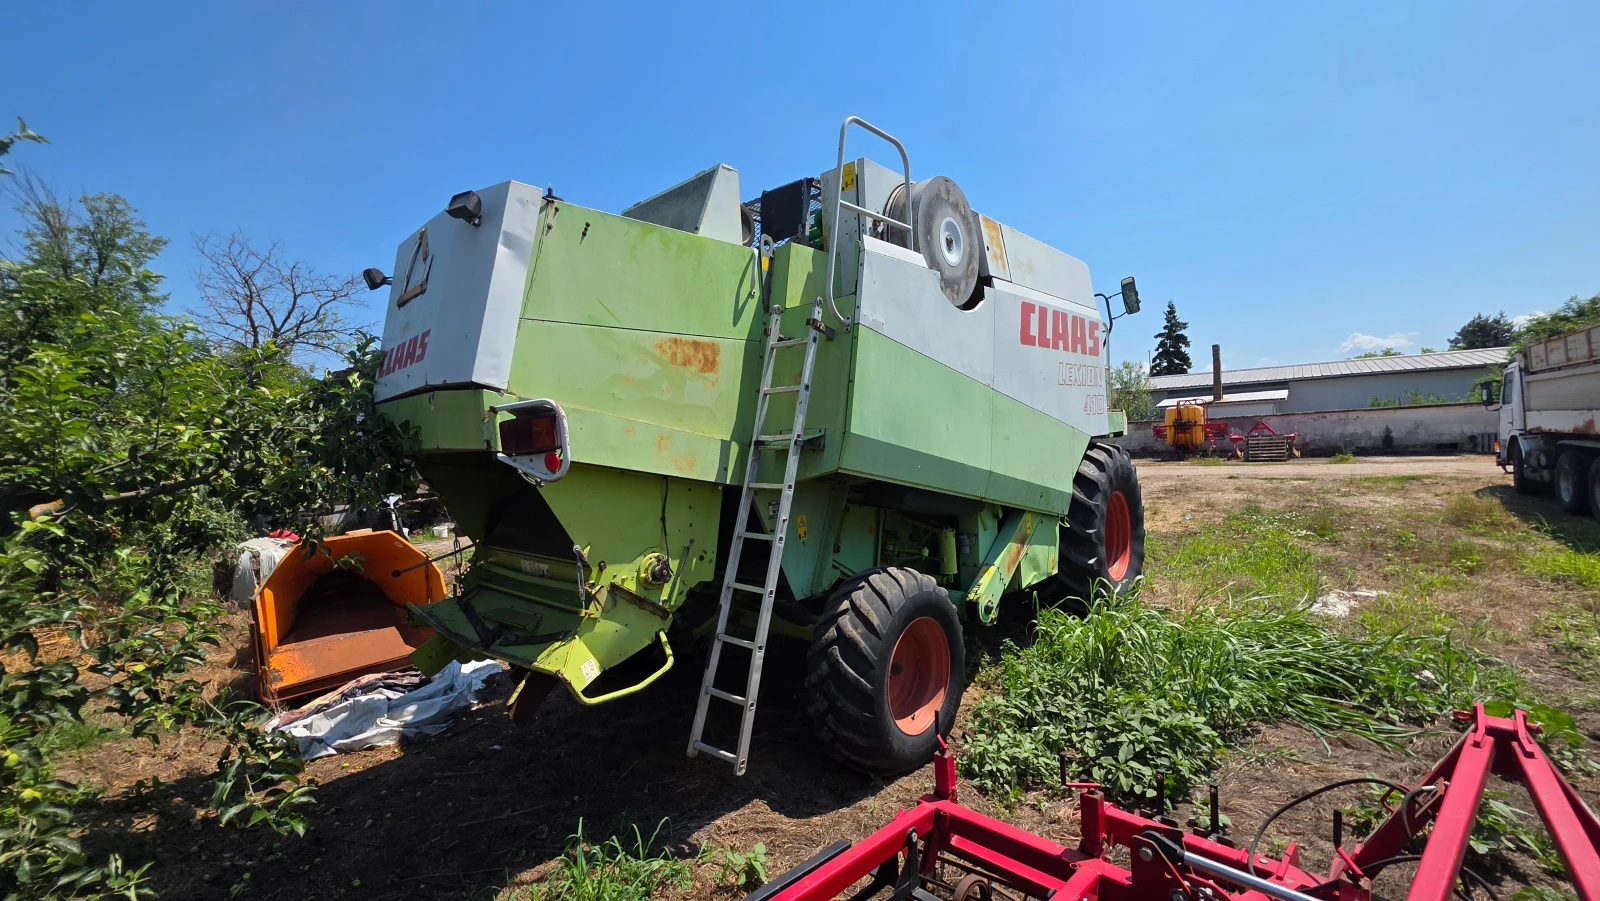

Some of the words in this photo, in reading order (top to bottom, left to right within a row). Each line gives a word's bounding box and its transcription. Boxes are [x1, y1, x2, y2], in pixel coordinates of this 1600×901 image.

[1020, 301, 1099, 357] CLAAS
[1058, 362, 1102, 387] LEXION
[1084, 395, 1104, 415] 410
